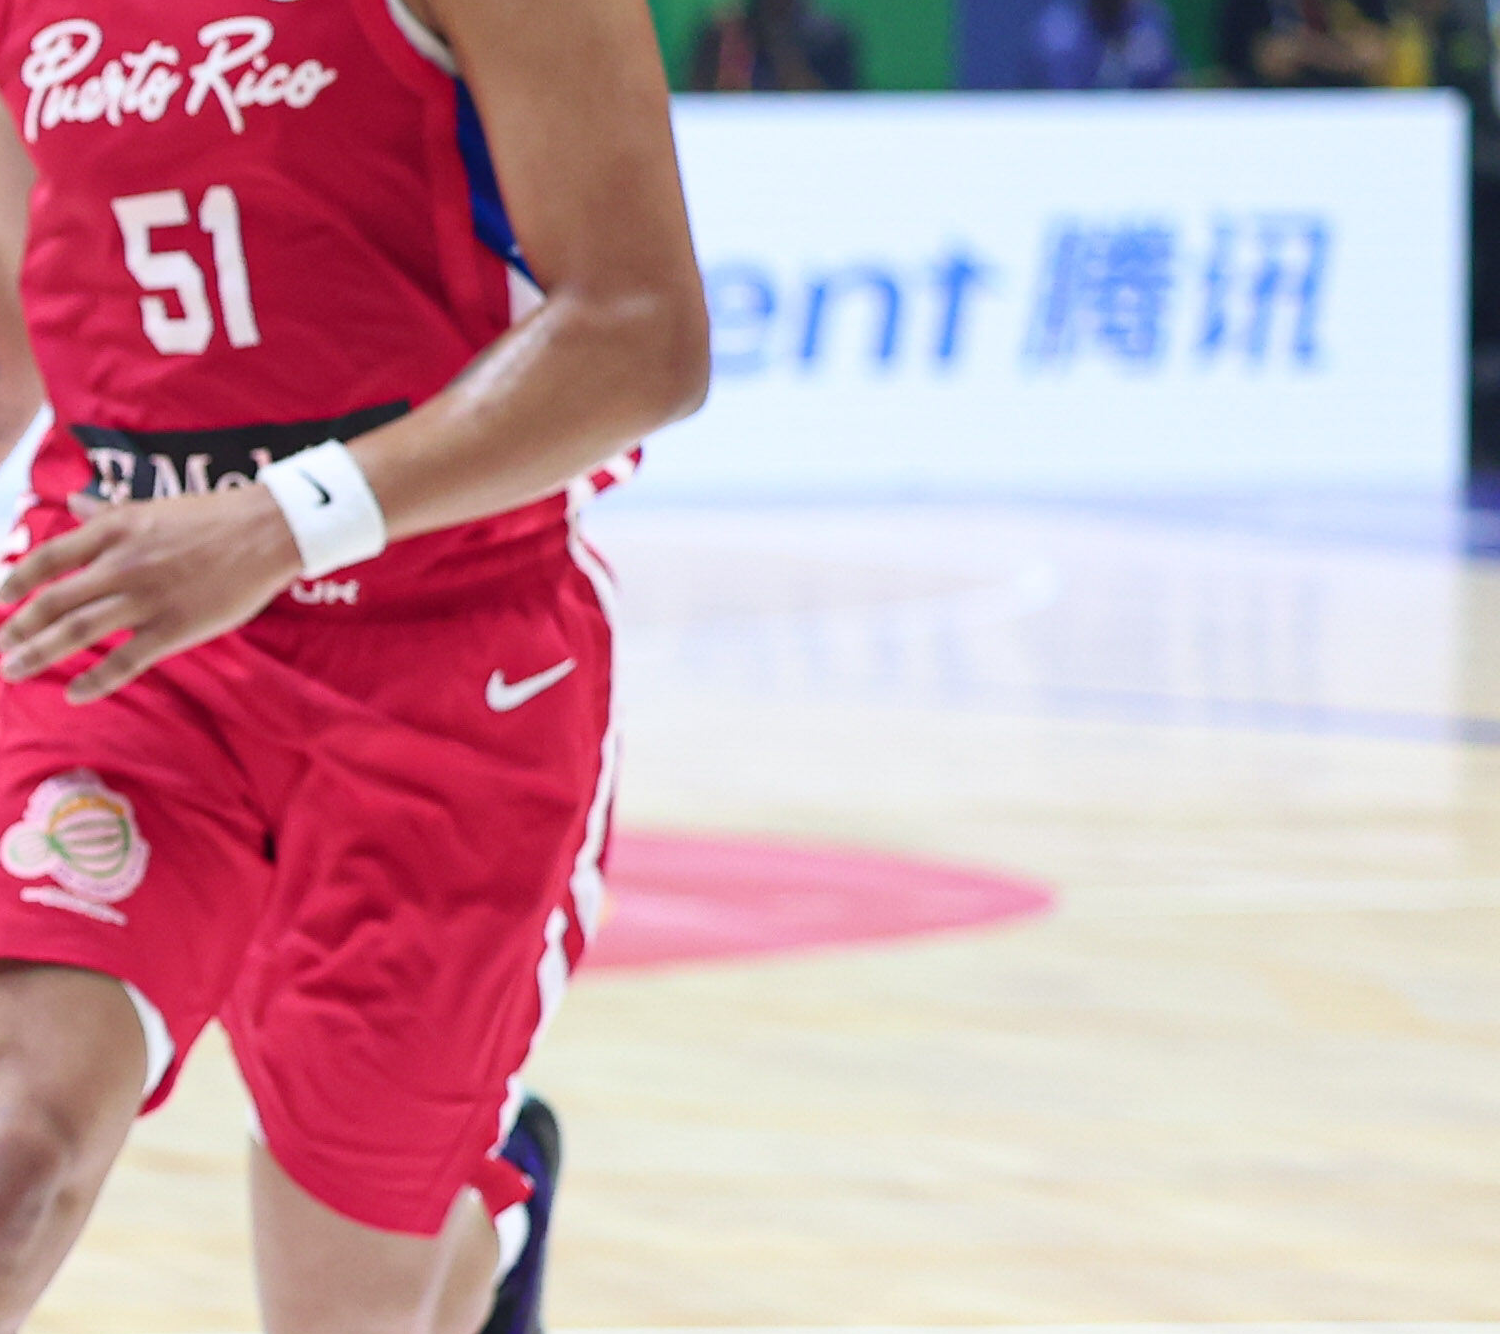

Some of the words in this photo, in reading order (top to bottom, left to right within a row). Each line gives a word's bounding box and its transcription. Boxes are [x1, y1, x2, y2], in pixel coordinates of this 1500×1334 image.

[21, 18, 183, 143] Puerto
[184, 16, 338, 134] Rico
[111, 184, 262, 356] 51
